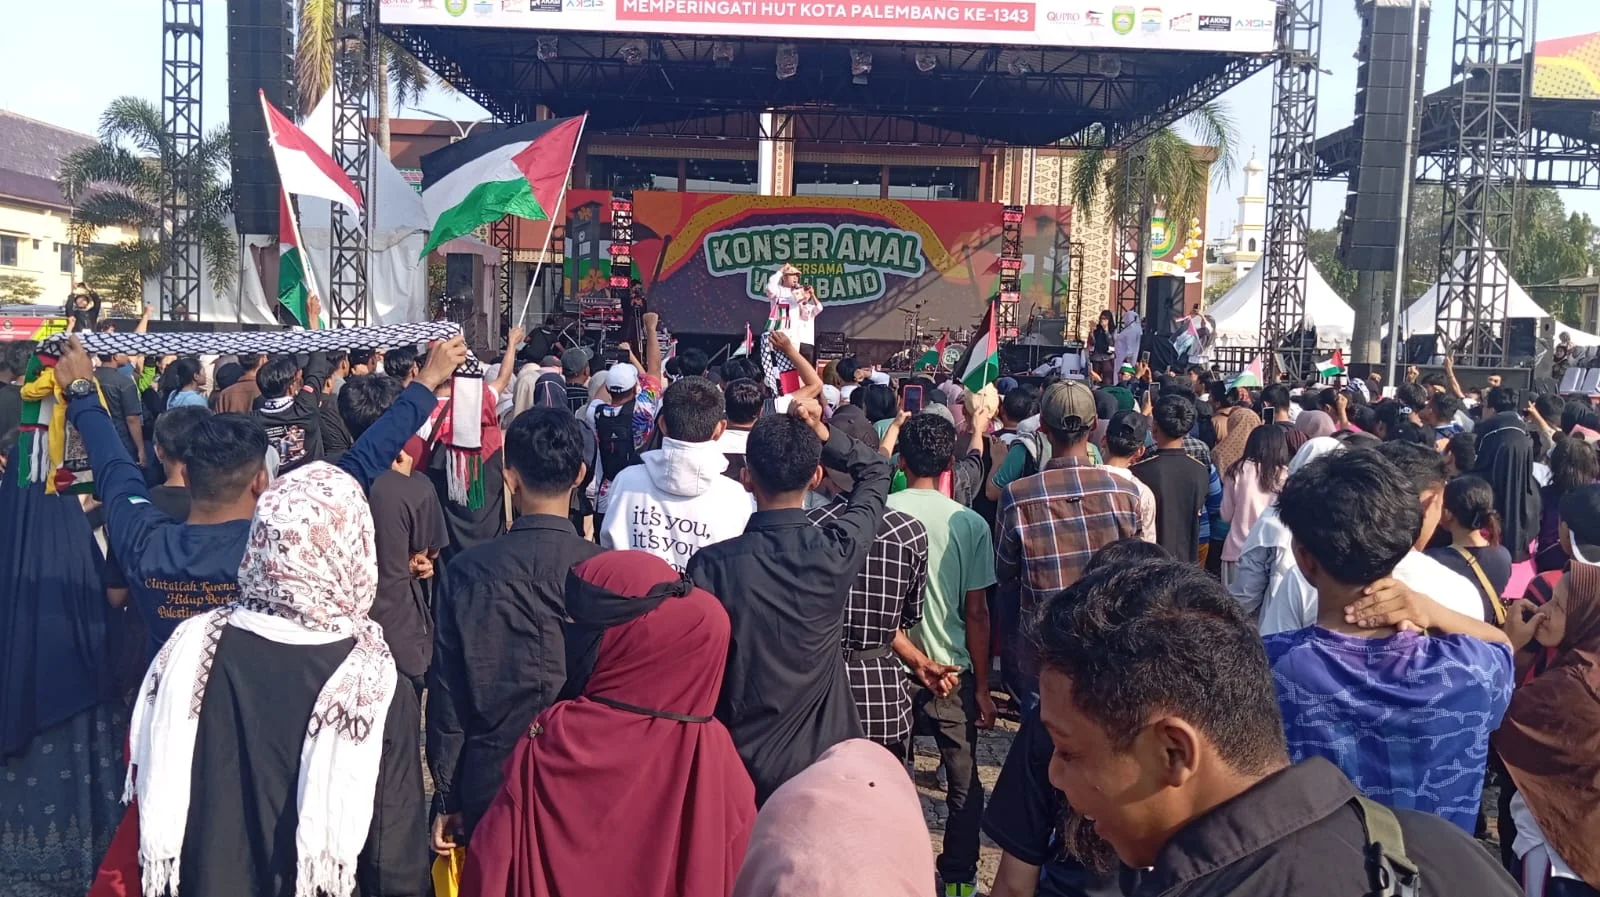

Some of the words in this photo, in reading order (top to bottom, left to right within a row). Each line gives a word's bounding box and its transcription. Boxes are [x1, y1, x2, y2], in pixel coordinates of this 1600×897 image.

[623, 0, 757, 17] MEMPERINGATI
[761, 3, 796, 17] HUT
[800, 3, 847, 18] KOTA
[851, 4, 960, 21] PALEMBANG
[963, 7, 1029, 23] KE-1343
[712, 232, 829, 268] KONSER
[837, 232, 916, 269] AMAL
[791, 262, 844, 275] ERSAMA
[816, 271, 879, 299] BAND
[665, 514, 711, 540] you,
[166, 592, 204, 607] Hidup
